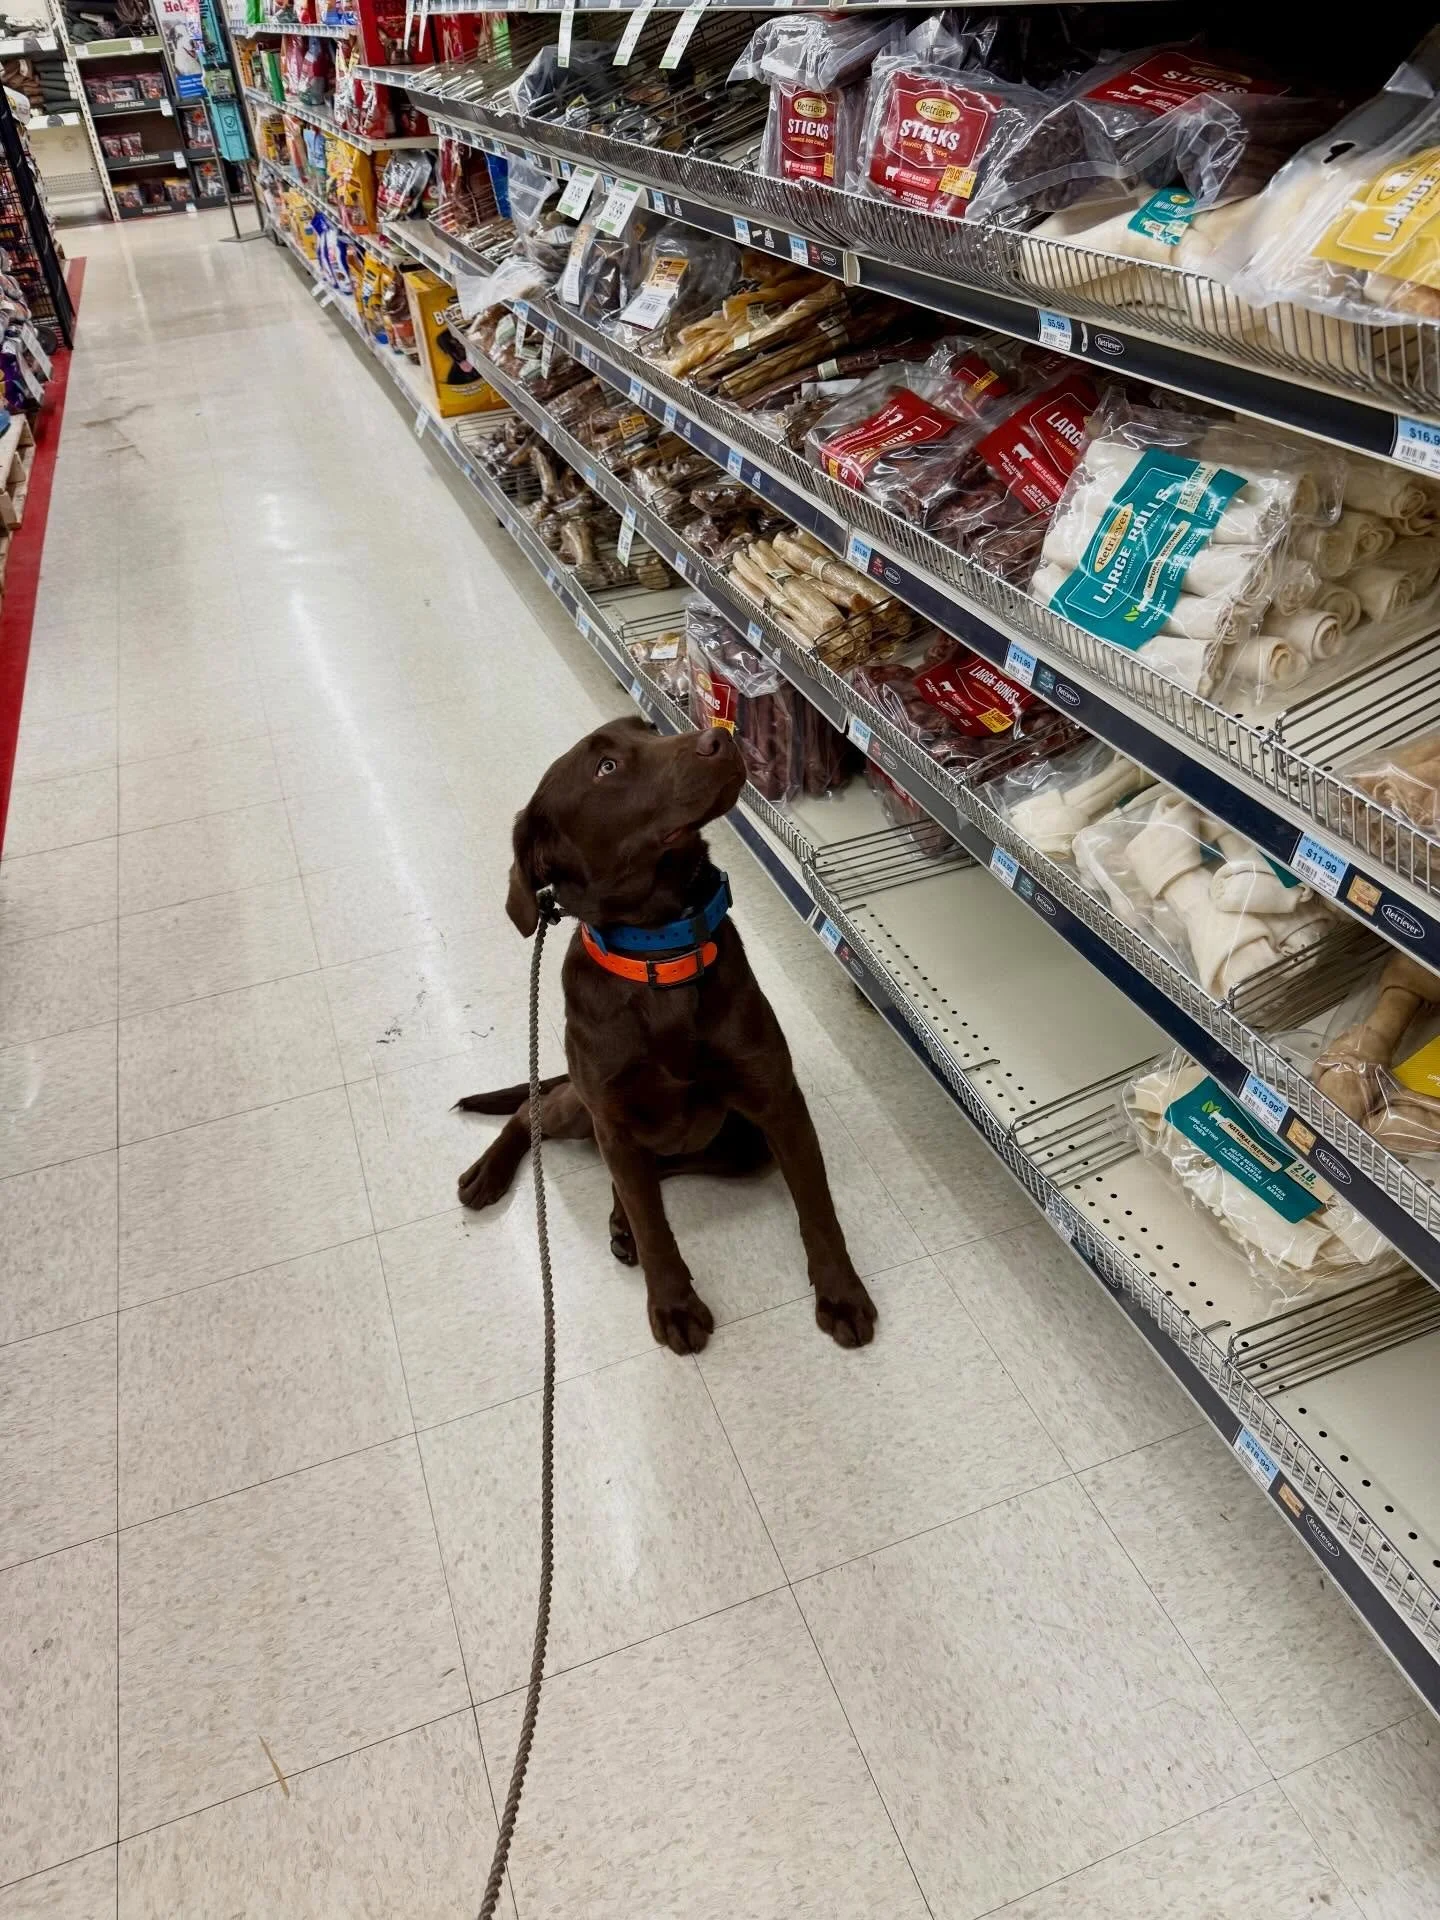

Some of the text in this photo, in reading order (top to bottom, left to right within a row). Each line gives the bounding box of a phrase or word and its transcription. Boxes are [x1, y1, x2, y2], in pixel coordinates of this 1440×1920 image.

[1161, 69, 1248, 95] STICKS
[797, 101, 826, 114] Retriever
[919, 102, 954, 118] Retriever
[788, 118, 829, 140] STICKS
[899, 119, 960, 151] STICKS
[1046, 411, 1083, 449] LARG
[1092, 488, 1170, 604] LARGE ROLLS
[1097, 511, 1134, 567] Retriever
[1013, 652, 1031, 669] $11.99
[969, 665, 998, 687] LARGE
[992, 680, 1020, 705] BONES
[1305, 848, 1337, 874] $11.99
[1385, 907, 1418, 934] Retriever
[1192, 1124, 1207, 1137] CHEW
[1228, 1123, 1276, 1166] NATURAL BEEFHIDE
[1228, 1147, 1244, 1162] HELPS
[1222, 1147, 1240, 1165] PLAQUE
[1244, 1165, 1262, 1182] TARTAR
[1294, 1164, 1302, 1172] 2
[1302, 1167, 1317, 1185] LB.
[1319, 1152, 1347, 1179] Retriever
[1266, 1186, 1284, 1201] BAKED
[1272, 1184, 1286, 1197] OVEN
[1309, 1519, 1335, 1551] Retriever
